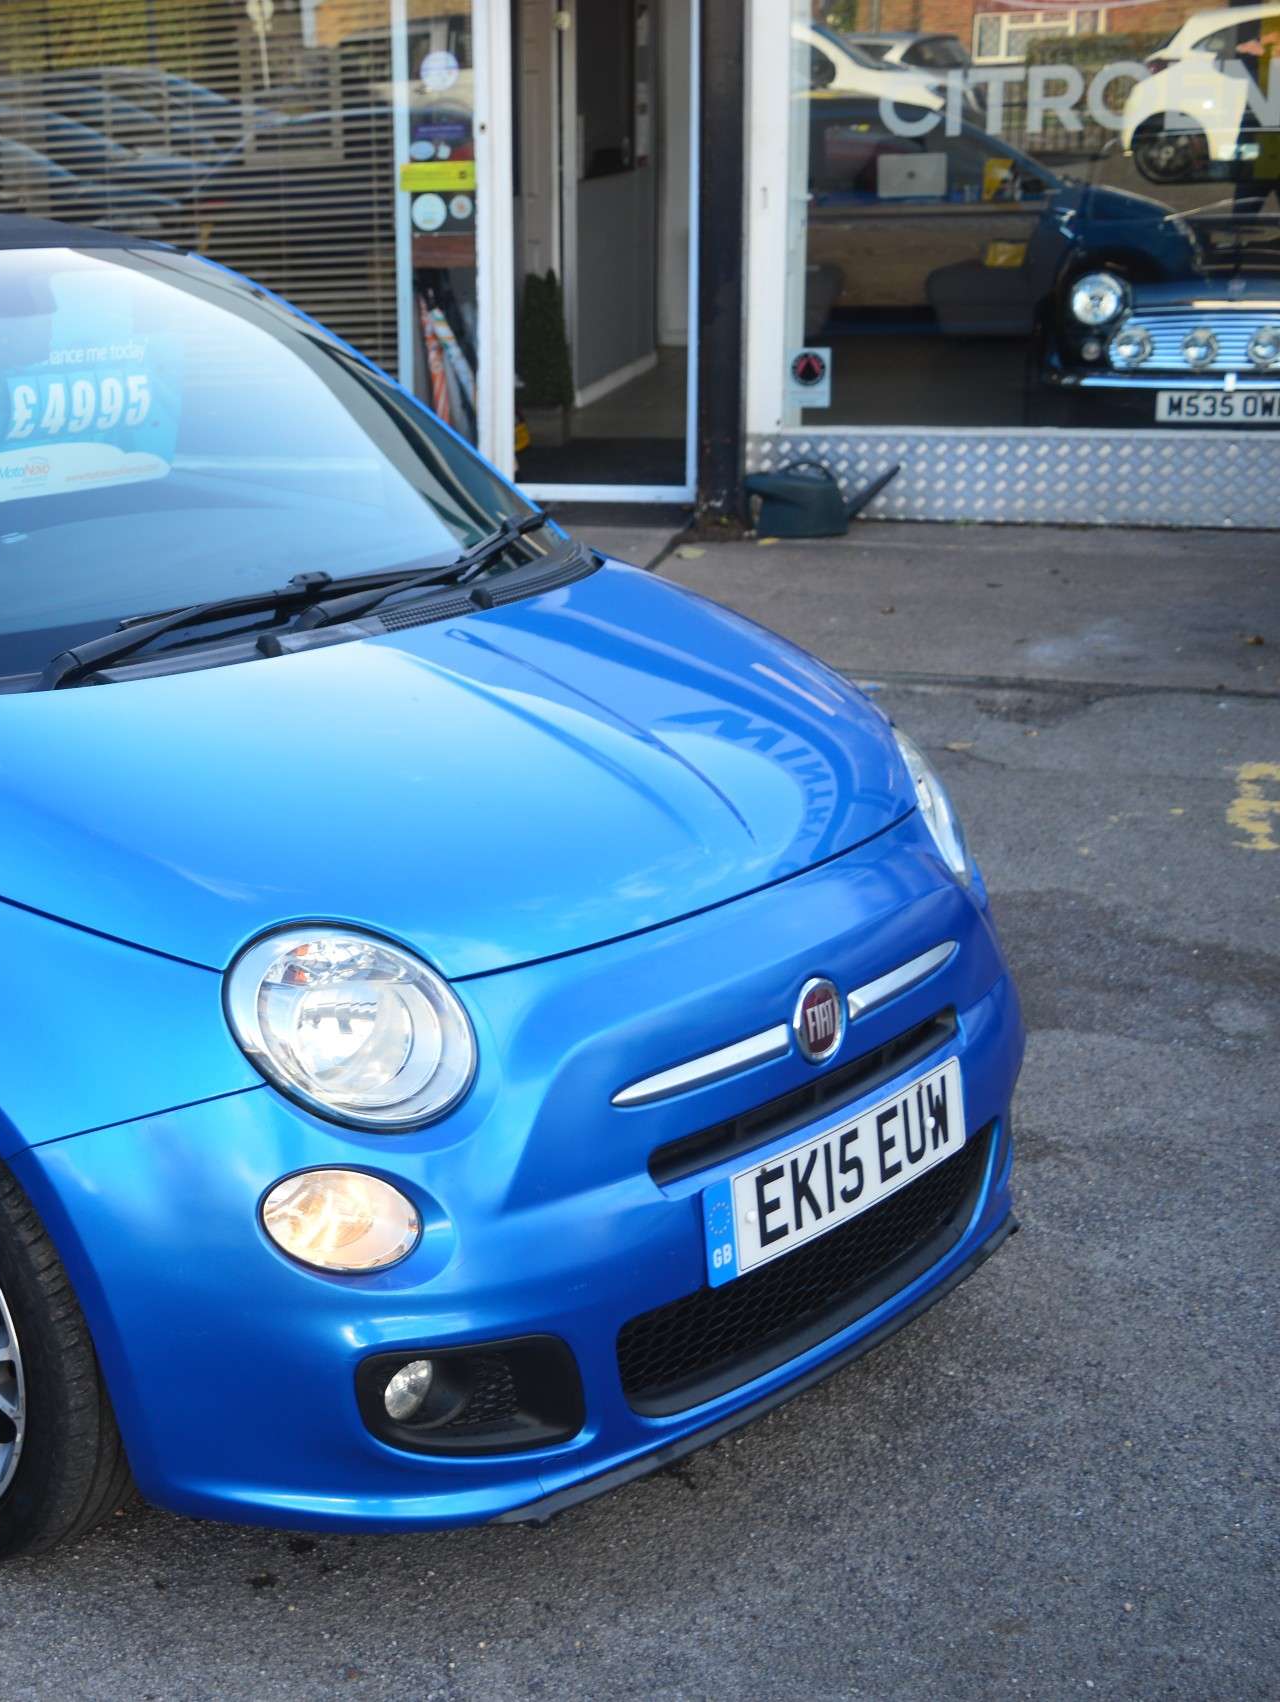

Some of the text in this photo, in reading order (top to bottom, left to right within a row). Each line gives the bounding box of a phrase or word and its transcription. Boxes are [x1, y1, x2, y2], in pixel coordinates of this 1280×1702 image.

[6, 374, 152, 440] £4995
[1167, 394, 1280, 417] M535 OW
[805, 998, 835, 1044] FIAT
[755, 1074, 949, 1249] EK15 EUW
[713, 1243, 733, 1268] GB
